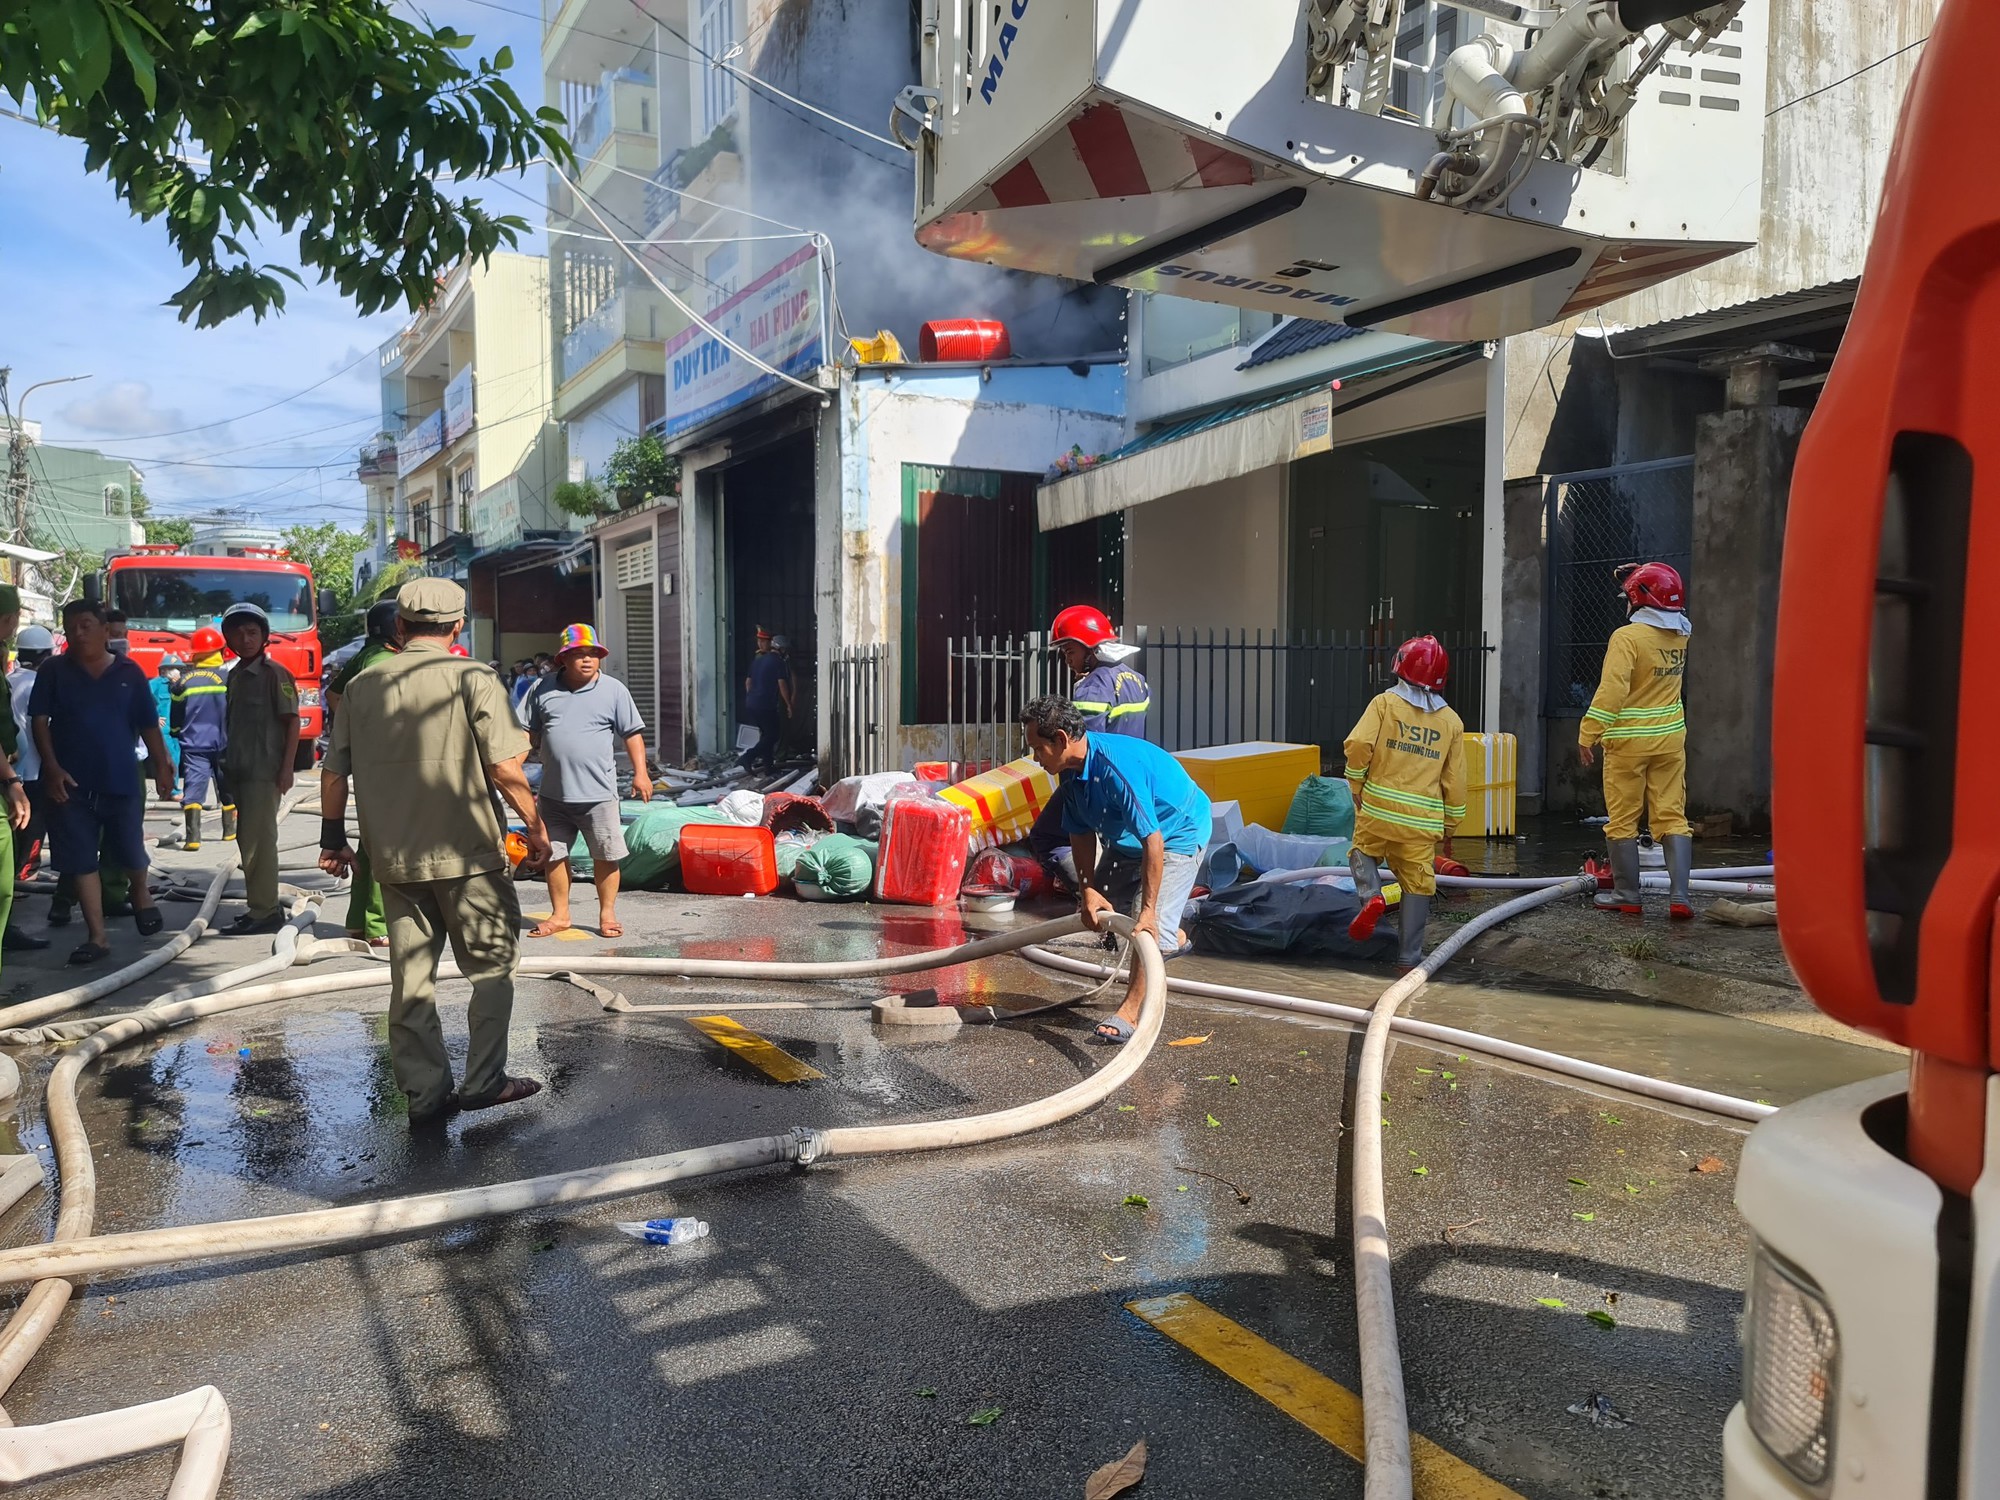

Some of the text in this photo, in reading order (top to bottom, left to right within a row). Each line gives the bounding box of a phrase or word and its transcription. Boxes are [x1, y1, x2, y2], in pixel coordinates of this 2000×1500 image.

[1155, 264, 1360, 306] MAGIRUS
[750, 313, 770, 350] HAI
[1386, 738, 1440, 760] FIRE FIGHTING TEAM
